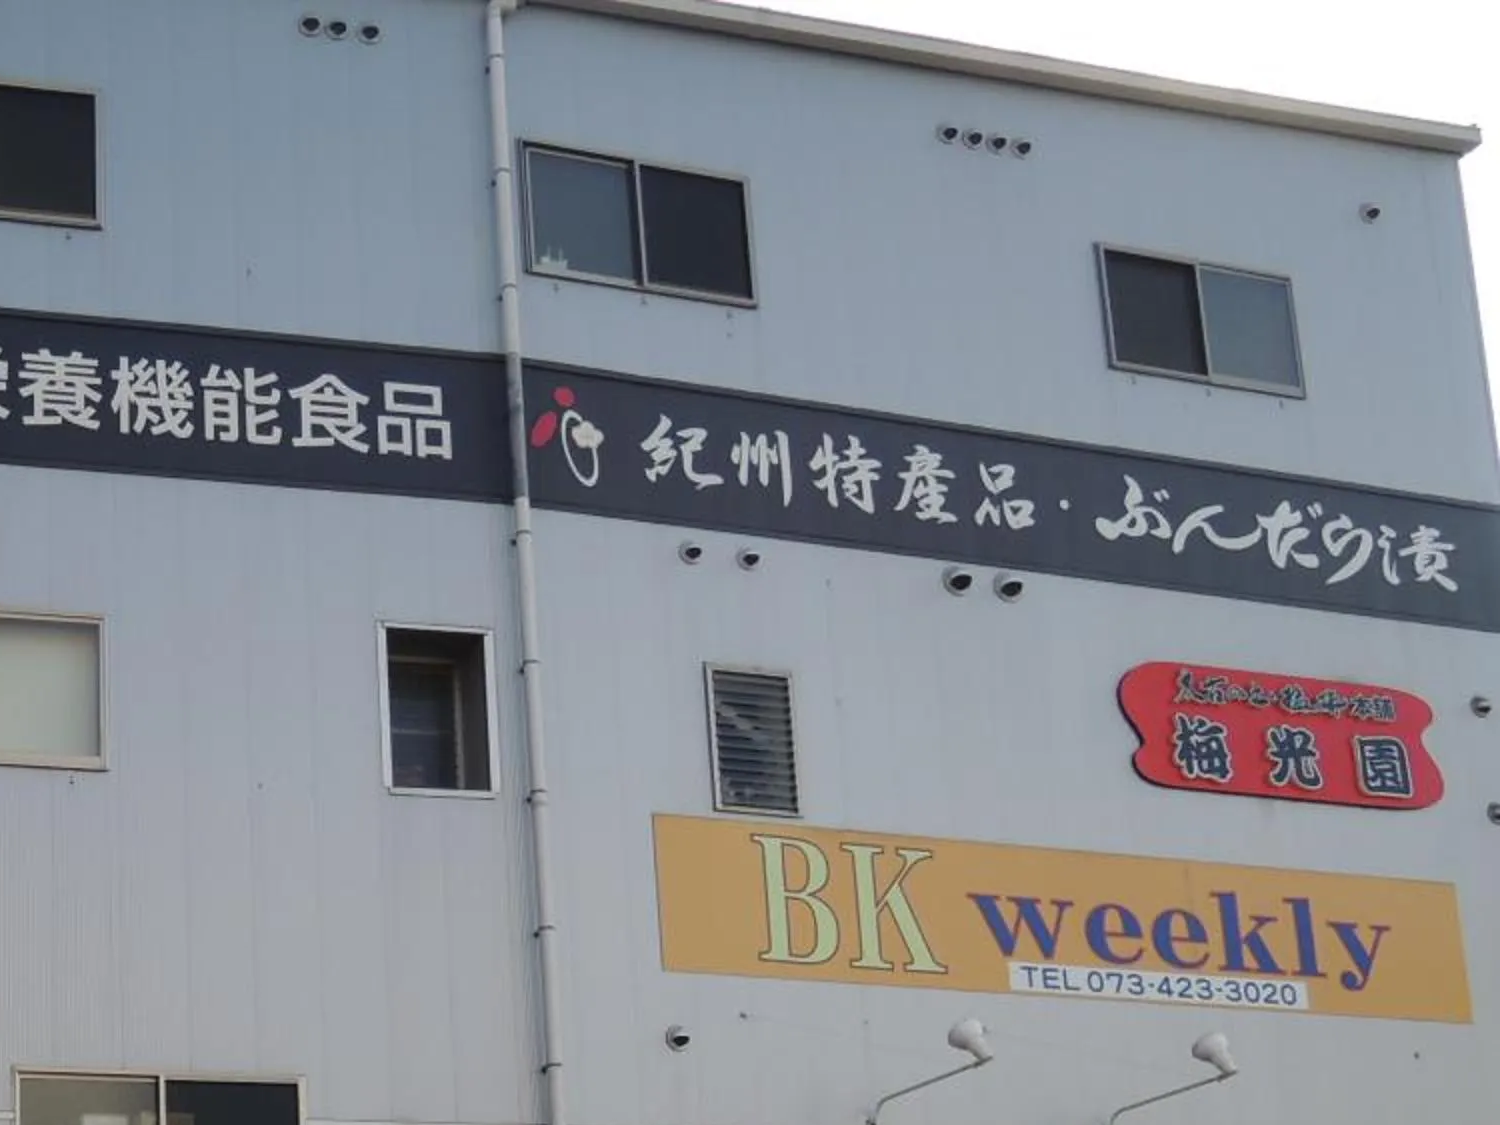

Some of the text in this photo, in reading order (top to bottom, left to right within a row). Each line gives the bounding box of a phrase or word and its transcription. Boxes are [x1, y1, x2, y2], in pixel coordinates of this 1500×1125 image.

[1174, 712, 1413, 797] 梅光園
[751, 833, 1391, 991] BK weekly
[1019, 965, 1081, 992] TEL
